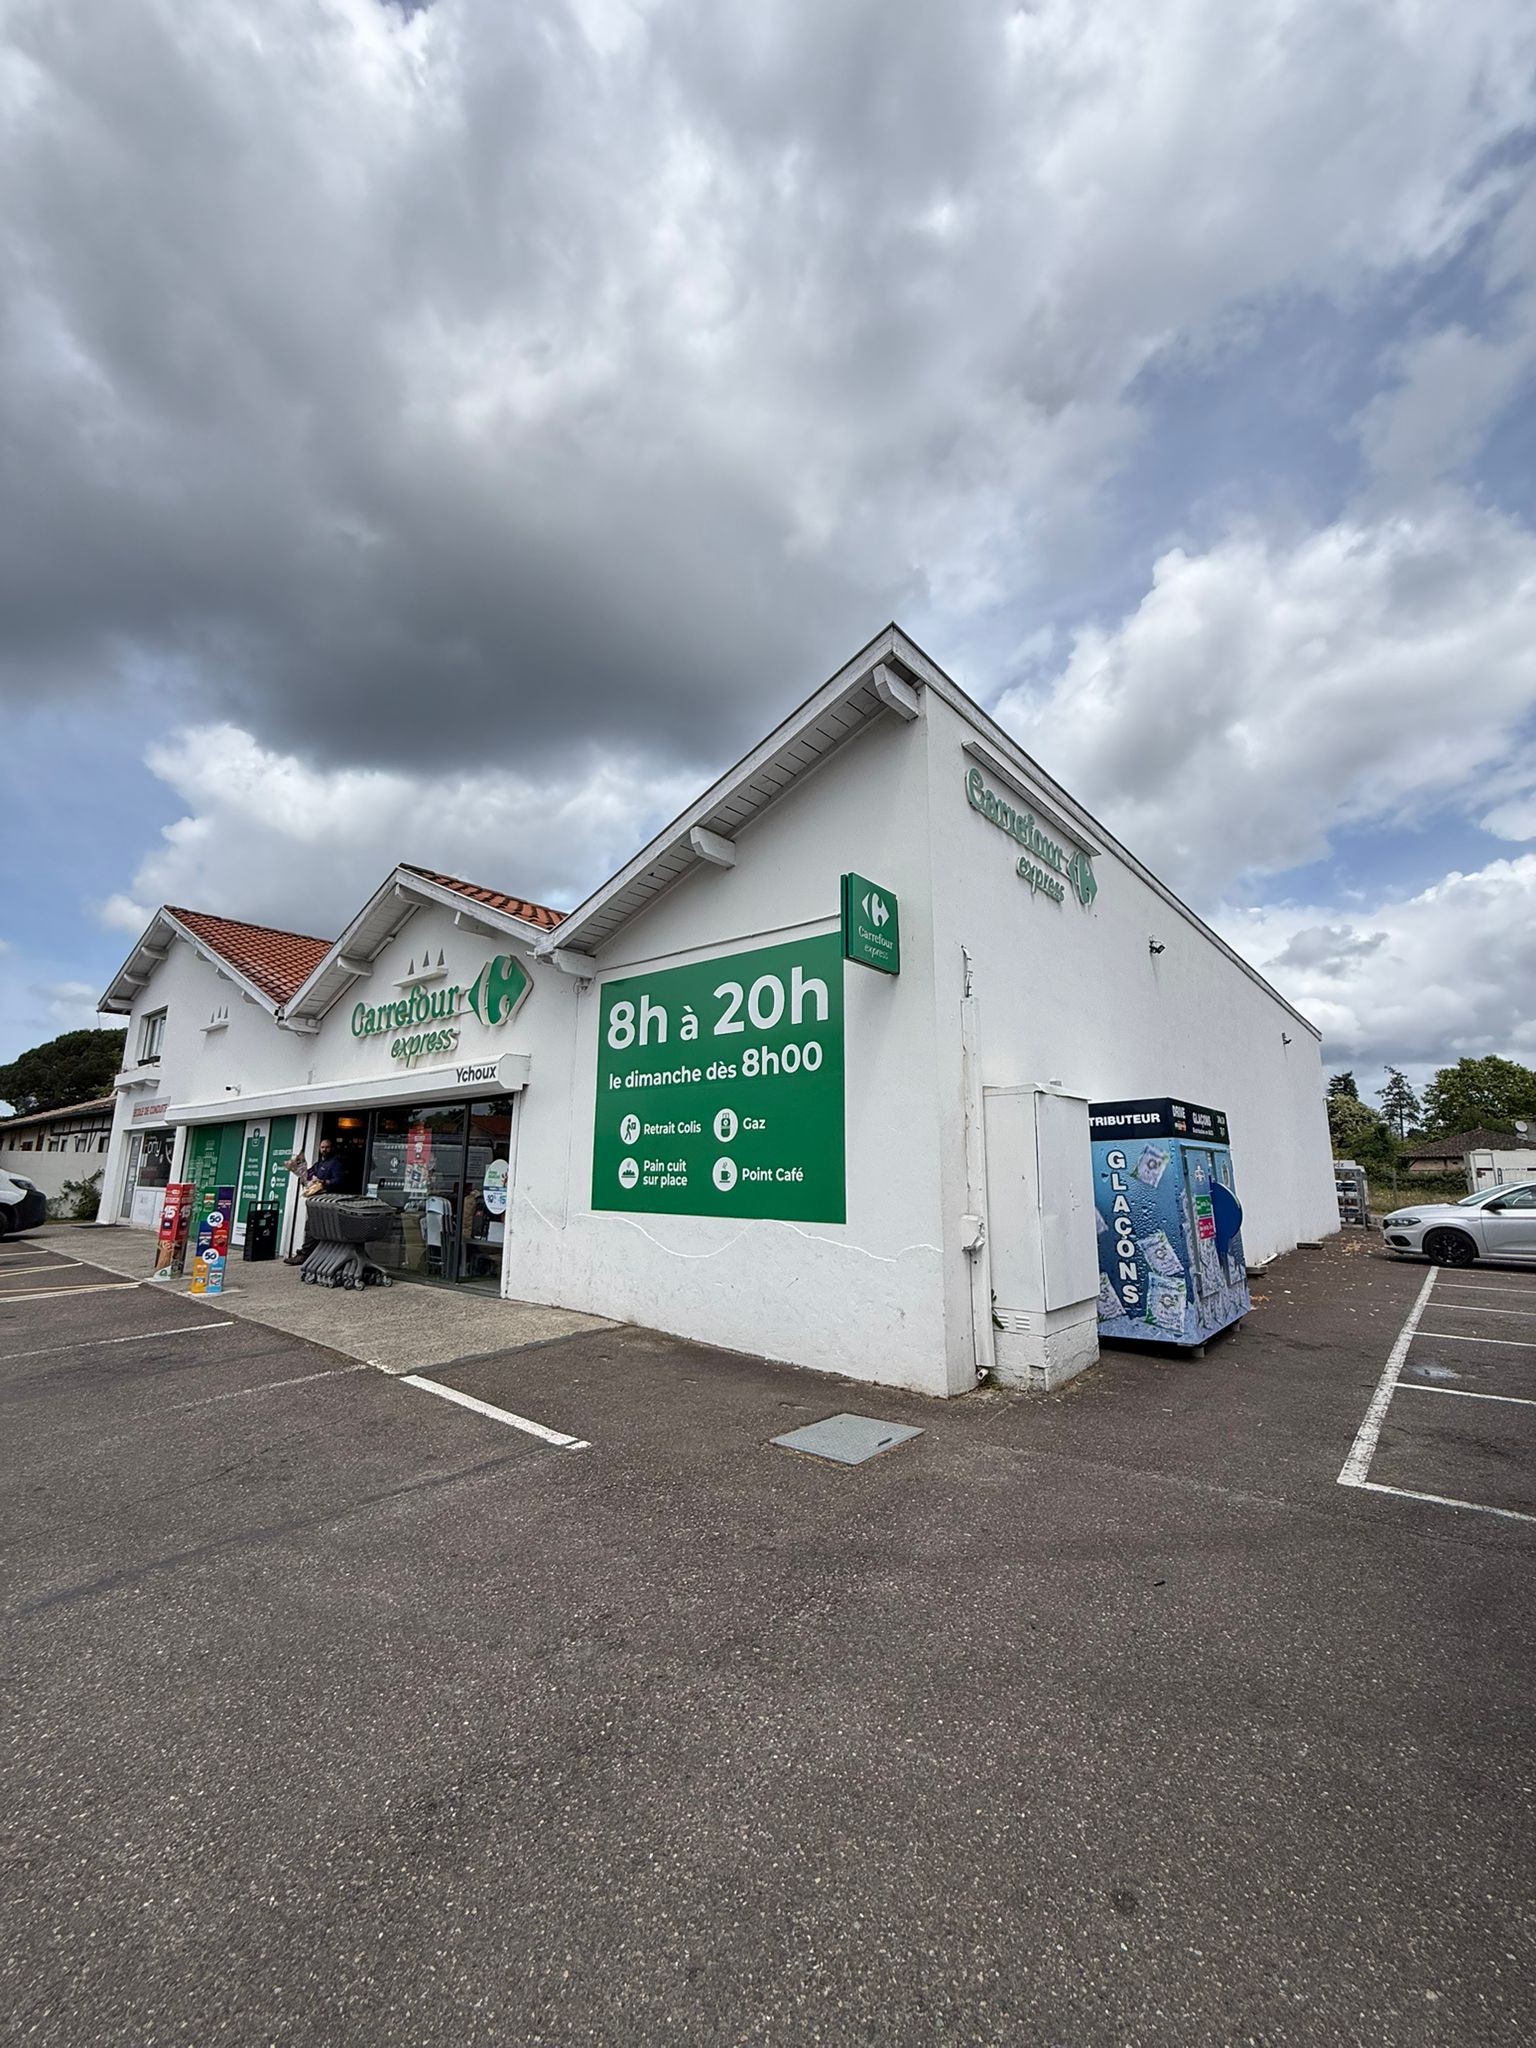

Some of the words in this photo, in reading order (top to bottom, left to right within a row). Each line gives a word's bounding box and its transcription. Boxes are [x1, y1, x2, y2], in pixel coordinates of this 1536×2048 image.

[1016, 856, 1065, 902] express
[858, 925, 894, 950] Carrefour
[864, 944, 889, 960] express
[351, 983, 460, 1037] Carrefour
[607, 994, 668, 1050] 8h
[679, 1005, 699, 1041] à
[713, 965, 829, 1036] 20h
[391, 1027, 456, 1068] express
[456, 1065, 497, 1083] Ychoux
[609, 1073, 622, 1090] le
[625, 1065, 702, 1088] dimanche
[706, 1060, 737, 1081] dès
[741, 1041, 823, 1077] 8h00
[643, 1121, 675, 1135] Retrait
[677, 1120, 701, 1134] Colis
[742, 1117, 766, 1130] Gaz
[643, 1159, 664, 1172] Pain
[666, 1159, 687, 1172] cuit
[643, 1175, 659, 1187] sur
[660, 1173, 688, 1189] place
[742, 1167, 773, 1182] Point
[775, 1167, 804, 1182] Café
[208, 1214, 222, 1224] 50
[1107, 1150, 1140, 1304] GLAÇONS
[204, 1251, 217, 1261] 50
